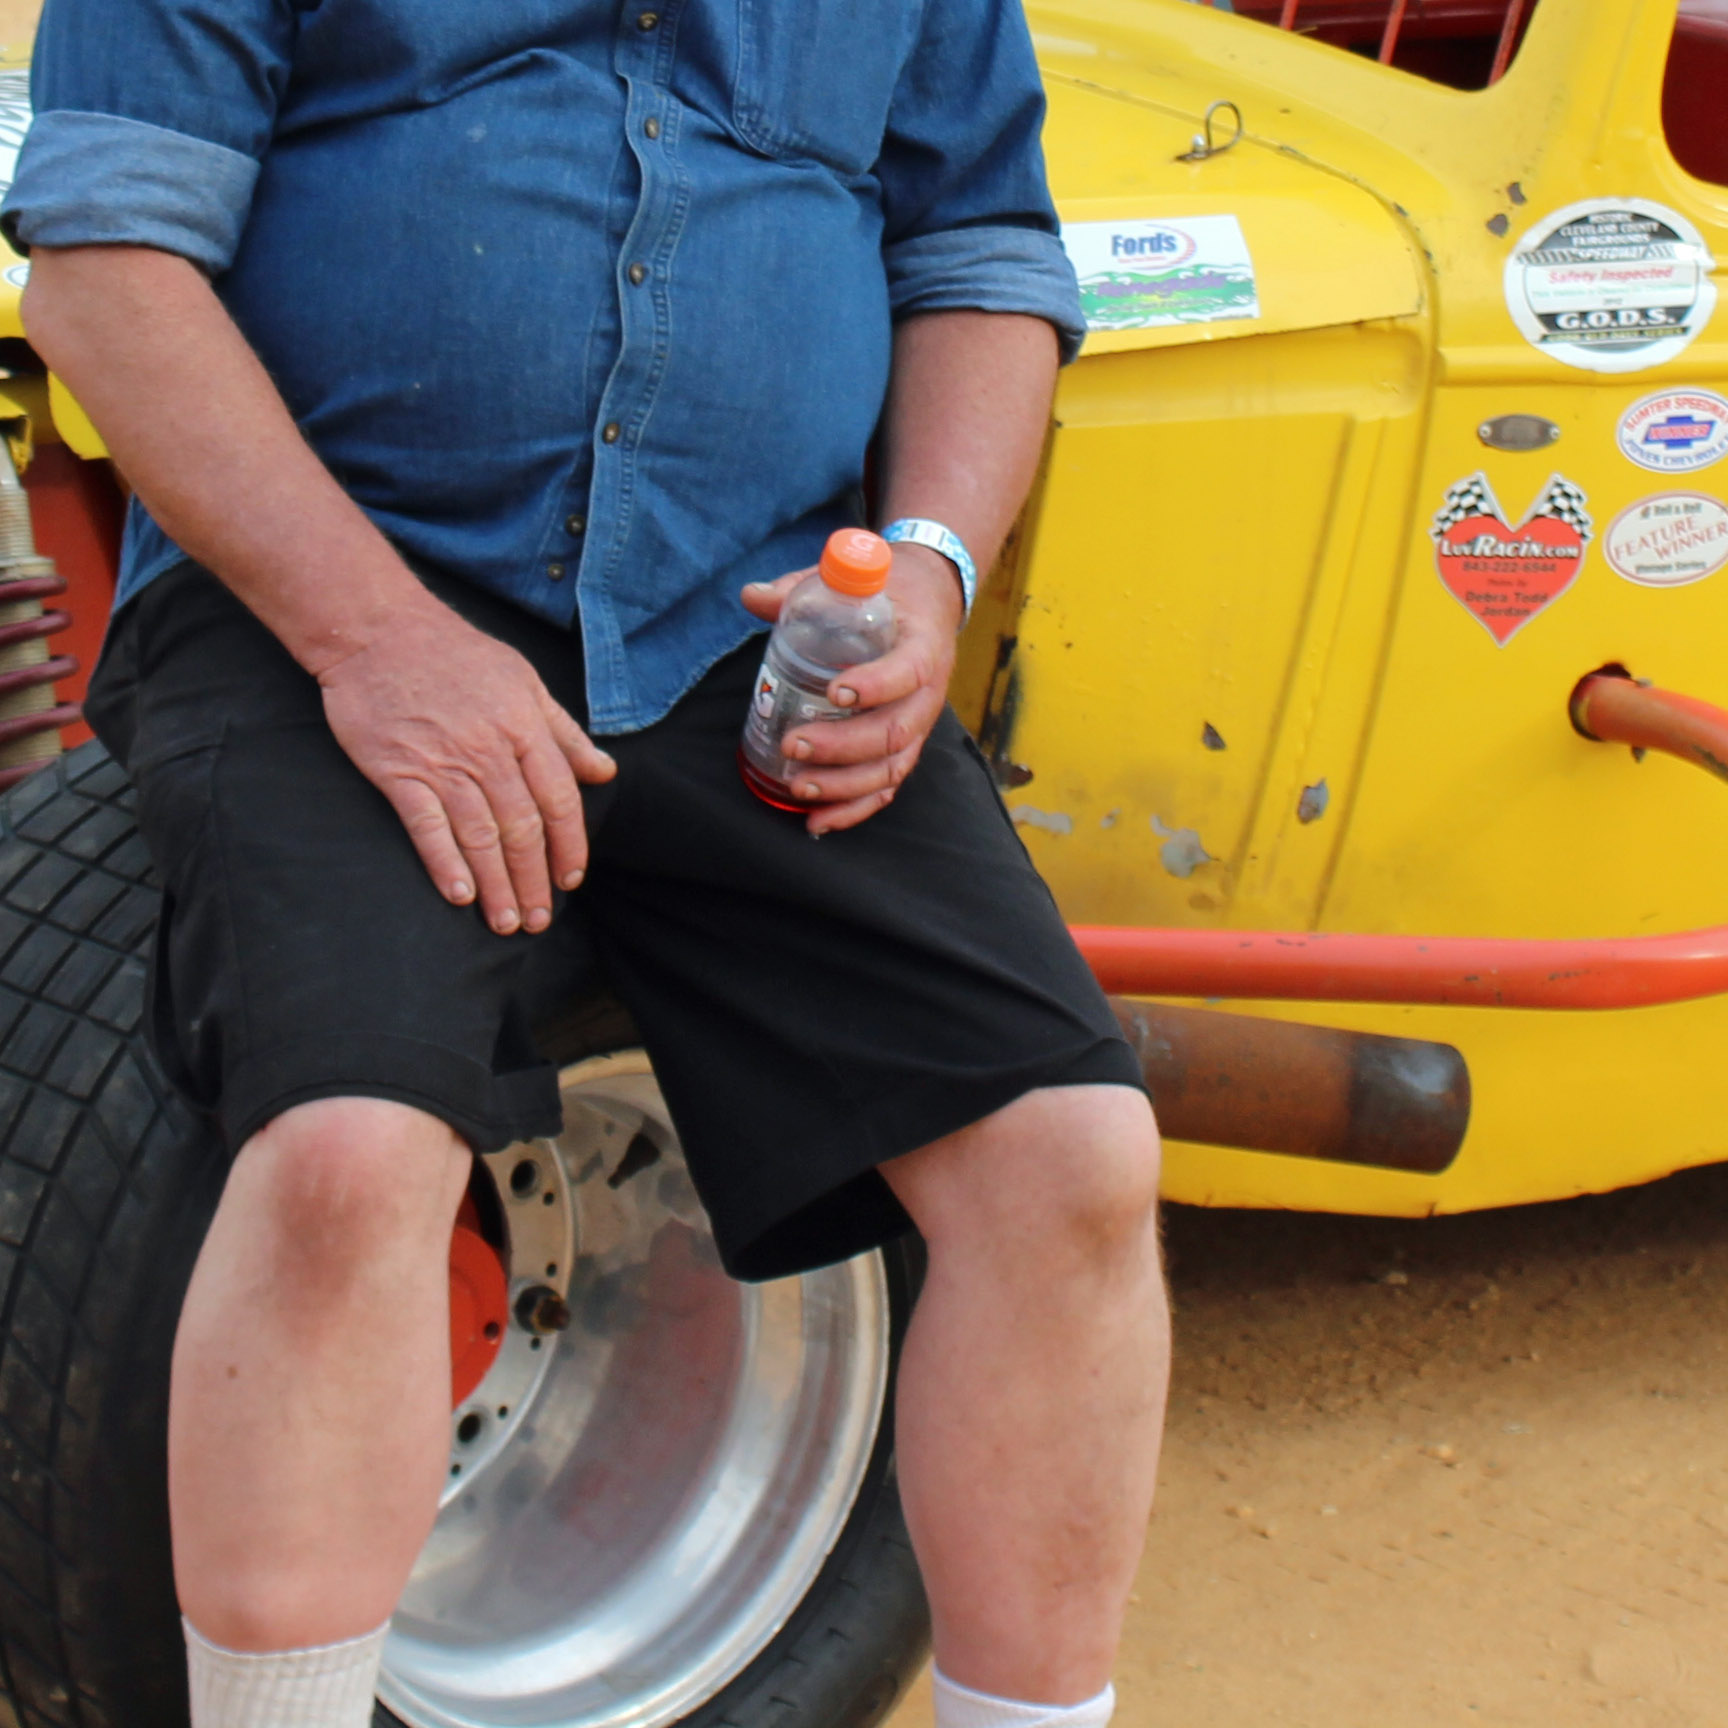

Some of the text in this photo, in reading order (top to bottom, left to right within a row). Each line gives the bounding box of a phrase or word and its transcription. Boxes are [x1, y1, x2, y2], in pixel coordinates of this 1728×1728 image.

[1548, 266, 1674, 284] Safety Inspected
[1555, 307, 1677, 330] G.O.D.S.
[1624, 397, 1672, 431] SUMTER
[1648, 423, 1711, 440] WINNER
[1613, 515, 1696, 561] FEATURE
[1654, 521, 1728, 560] WINNER
